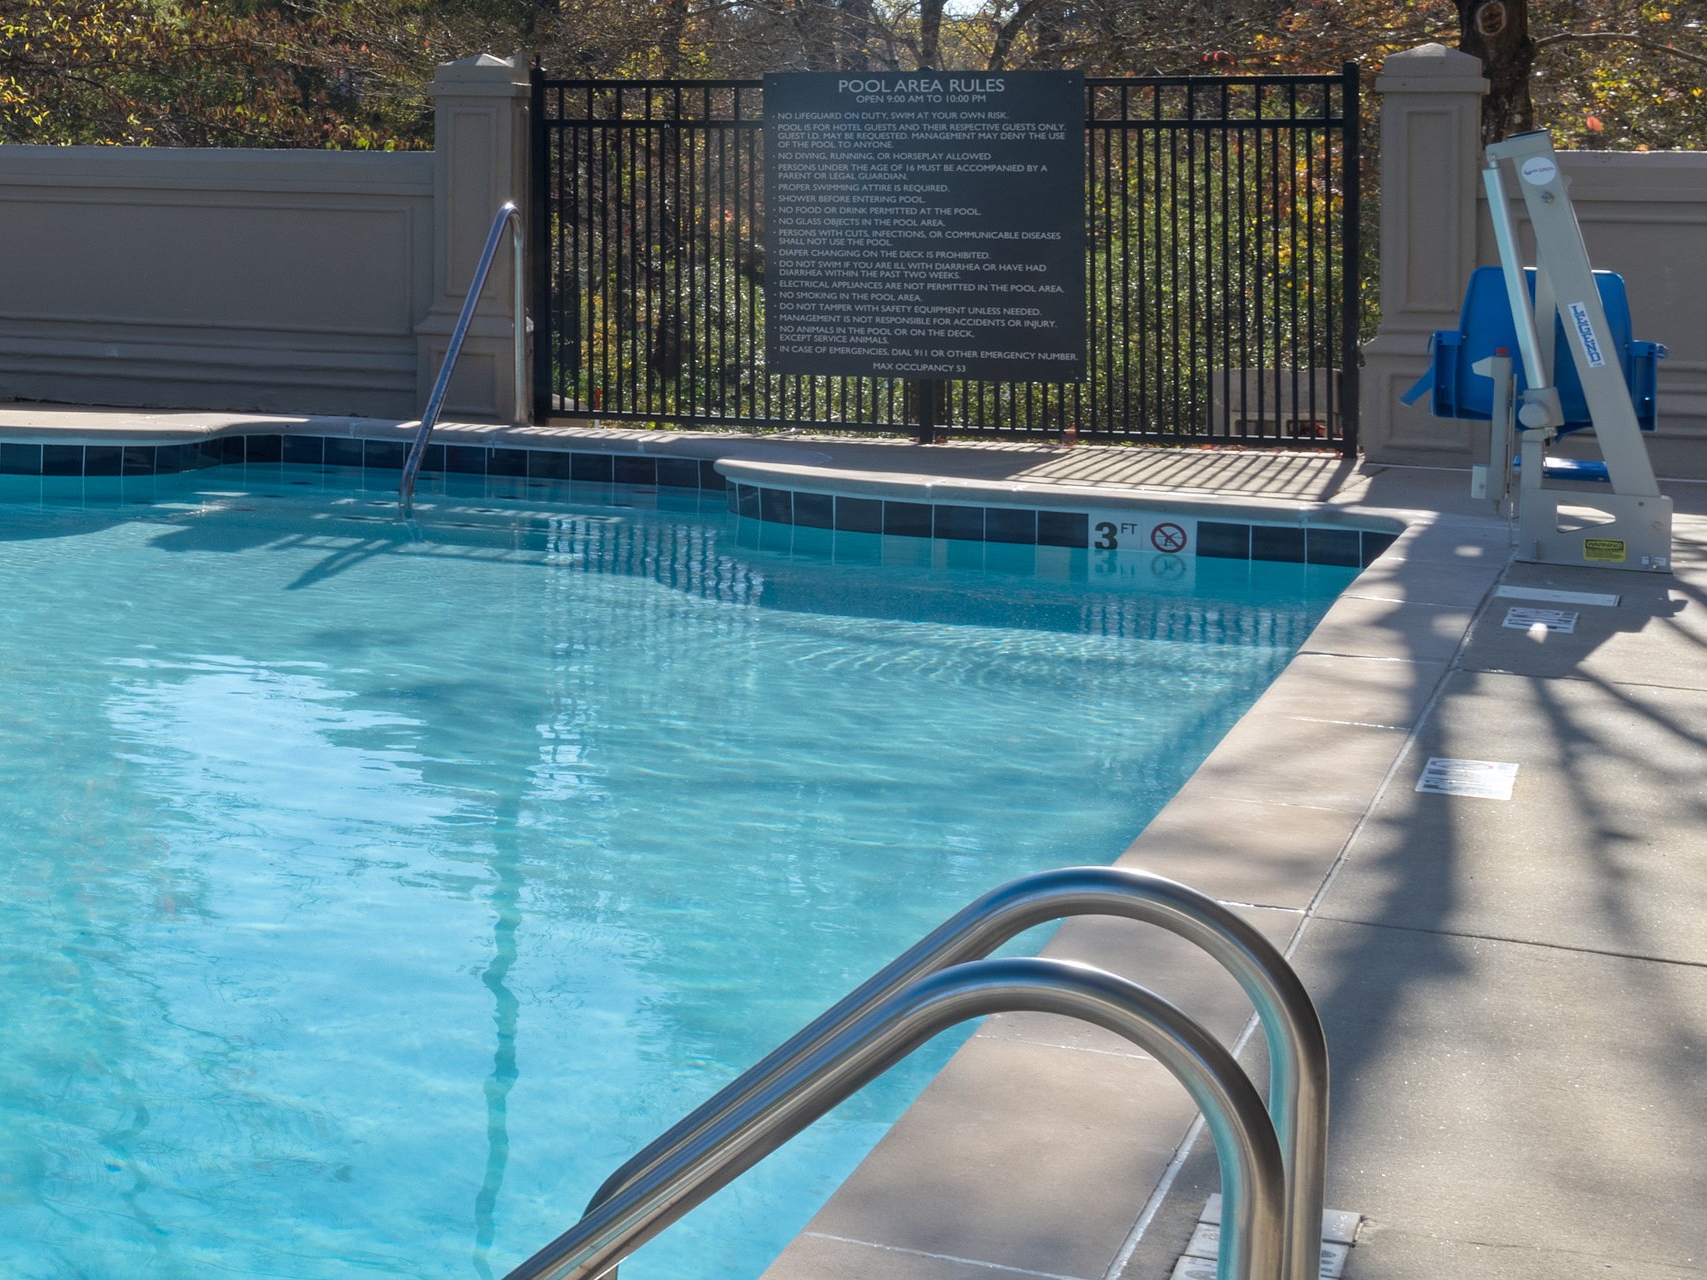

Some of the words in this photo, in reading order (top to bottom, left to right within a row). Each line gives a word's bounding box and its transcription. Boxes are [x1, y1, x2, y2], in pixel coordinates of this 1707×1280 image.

[838, 79, 890, 92] POOL
[893, 79, 943, 92] AREA
[949, 78, 1004, 91] RULES
[946, 94, 969, 102] 10:00
[972, 94, 985, 102] PM
[945, 152, 991, 160] ALLOWED
[813, 183, 859, 191] SWIMMING
[903, 184, 949, 192] REQUIRED.
[934, 207, 951, 215] THE
[779, 248, 808, 256] DIAPER
[810, 249, 860, 257] CHANGING
[899, 250, 923, 258] DECK
[935, 251, 990, 259] PROHIBITED.
[935, 262, 980, 270] DIARRHEA
[999, 263, 1023, 271] HAVE
[779, 280, 829, 288] ELECTRICAL
[831, 281, 882, 289] APPLIANCES
[927, 283, 975, 291] PERMITTED
[1010, 284, 1036, 292] POOL
[818, 303, 851, 311] TAMPER
[914, 305, 965, 314] EQUIPMENT
[968, 306, 1000, 314] UNLESS
[1003, 307, 1042, 315] NEEDED.
[779, 314, 841, 322] MANAGEMENT
[852, 315, 872, 323] NOT
[875, 316, 930, 324] RESPONSIBLE
[933, 317, 951, 325] FOR
[953, 318, 1005, 326] ACCIDENTS
[1007, 319, 1021, 327] OR
[1024, 320, 1057, 328] INJURY.
[1571, 305, 1601, 362] LEGEND
[791, 345, 812, 353] CASE
[891, 348, 912, 356] DIAL
[930, 349, 944, 357] OR
[980, 350, 1035, 359] EMERGENCY
[1037, 352, 1078, 360] NUMBER.
[895, 363, 953, 372] OCCUPANCY
[956, 364, 966, 372] 53
